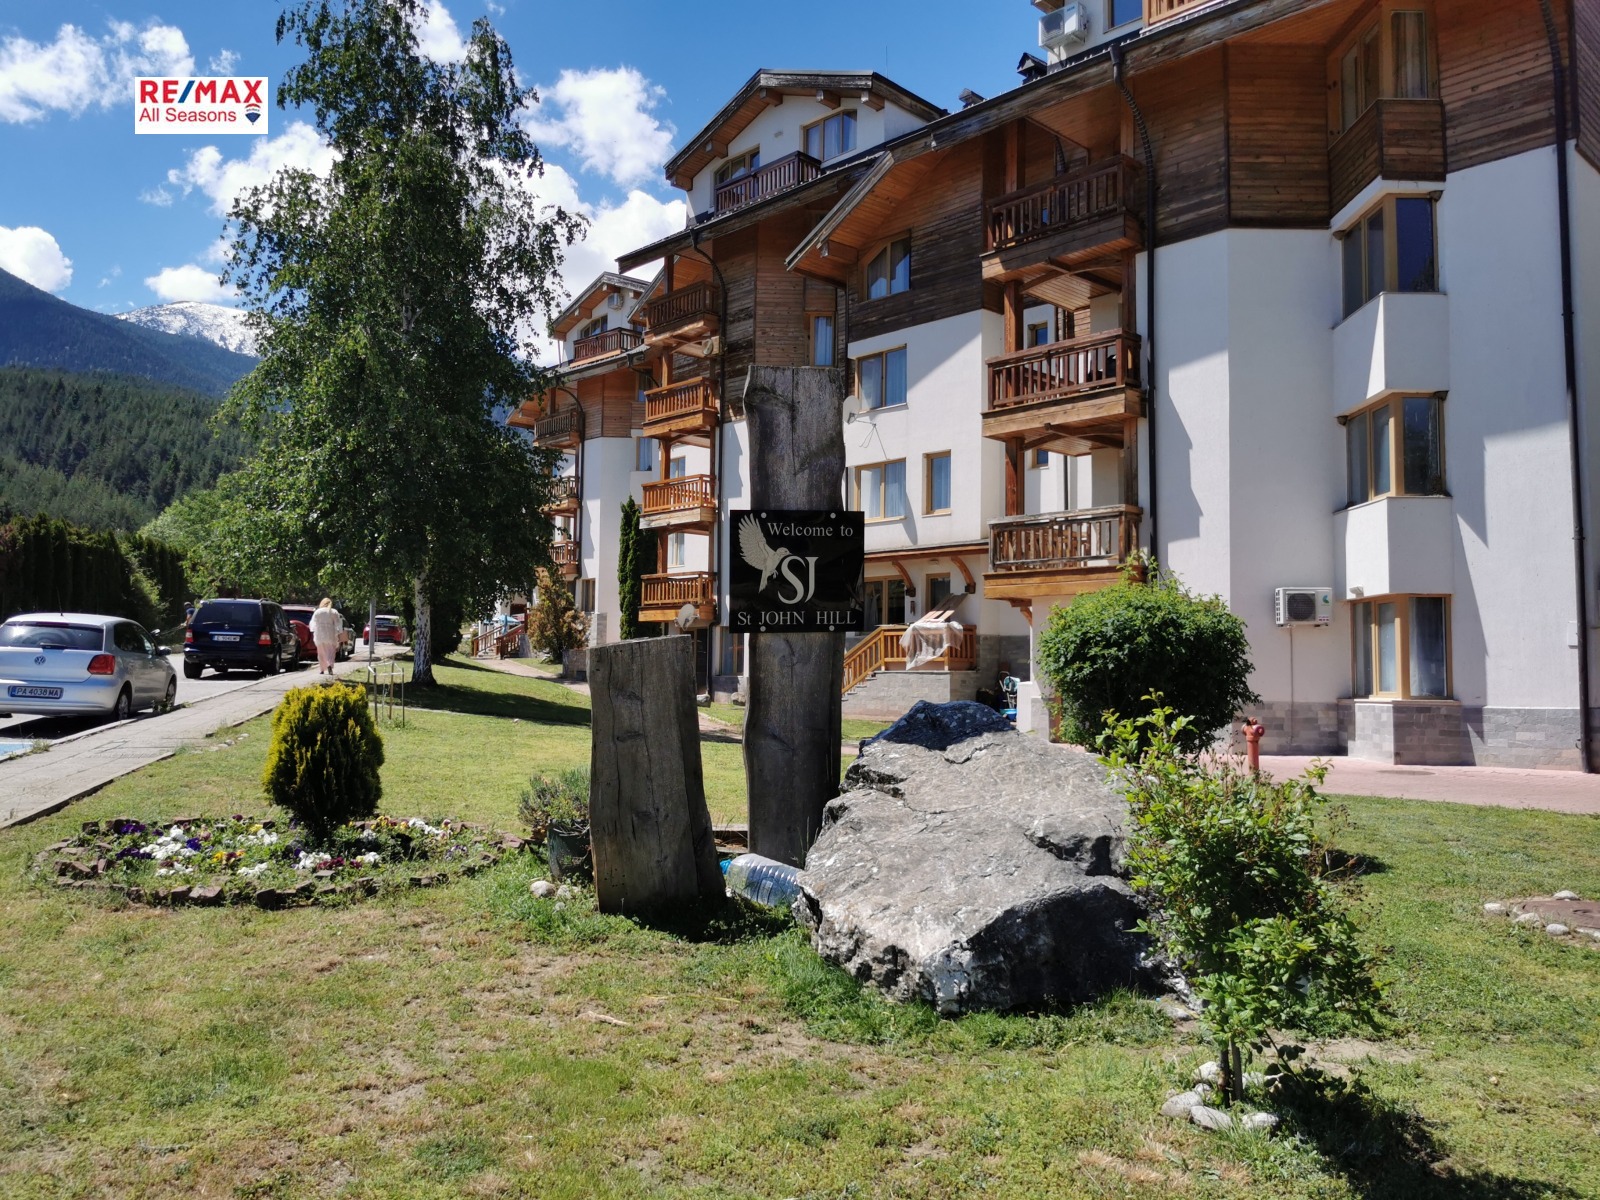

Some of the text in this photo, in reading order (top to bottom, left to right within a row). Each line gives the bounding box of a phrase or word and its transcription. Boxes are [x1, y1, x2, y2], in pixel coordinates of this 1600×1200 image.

[767, 522, 854, 537] Welcome to
[777, 555, 819, 605] SJ
[737, 610, 857, 625] St JOHN HILL
